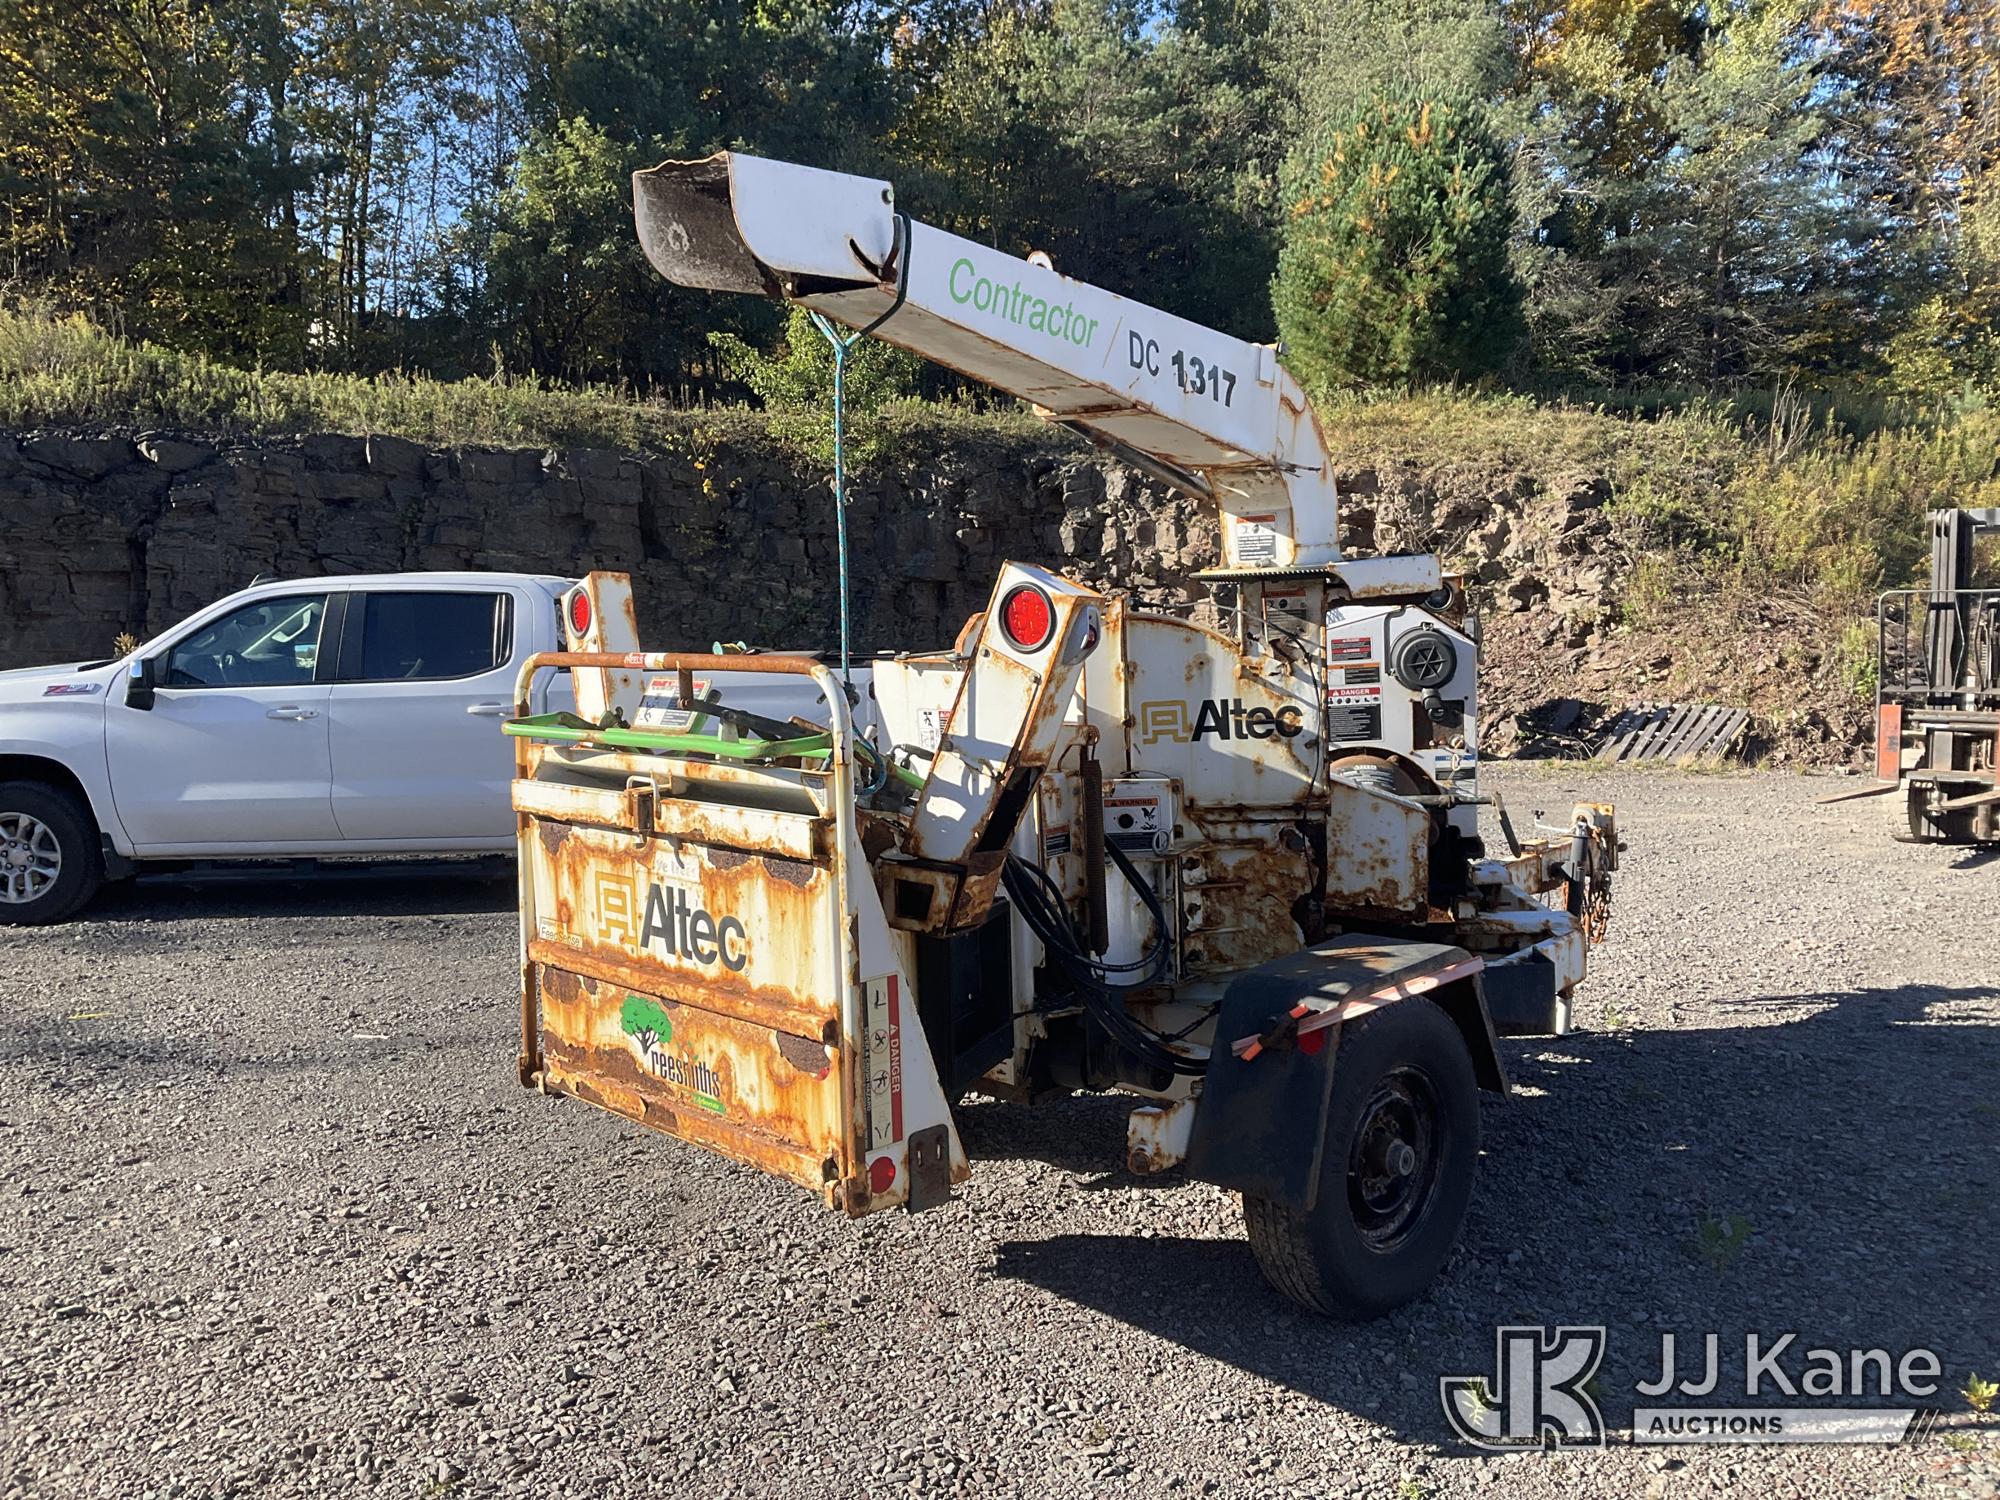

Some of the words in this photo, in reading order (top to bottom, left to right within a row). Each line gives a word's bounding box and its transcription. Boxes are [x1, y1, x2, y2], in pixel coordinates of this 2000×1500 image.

[949, 258, 1099, 348] Contractor
[1128, 329, 1160, 377] DC
[1171, 349, 1237, 408] 1317
[1190, 698, 1304, 742] Altec
[1340, 688, 1370, 696] DANGER
[1119, 798, 1153, 807] WARNING
[640, 883, 747, 972] Altec
[890, 1038, 901, 1094] DANGER
